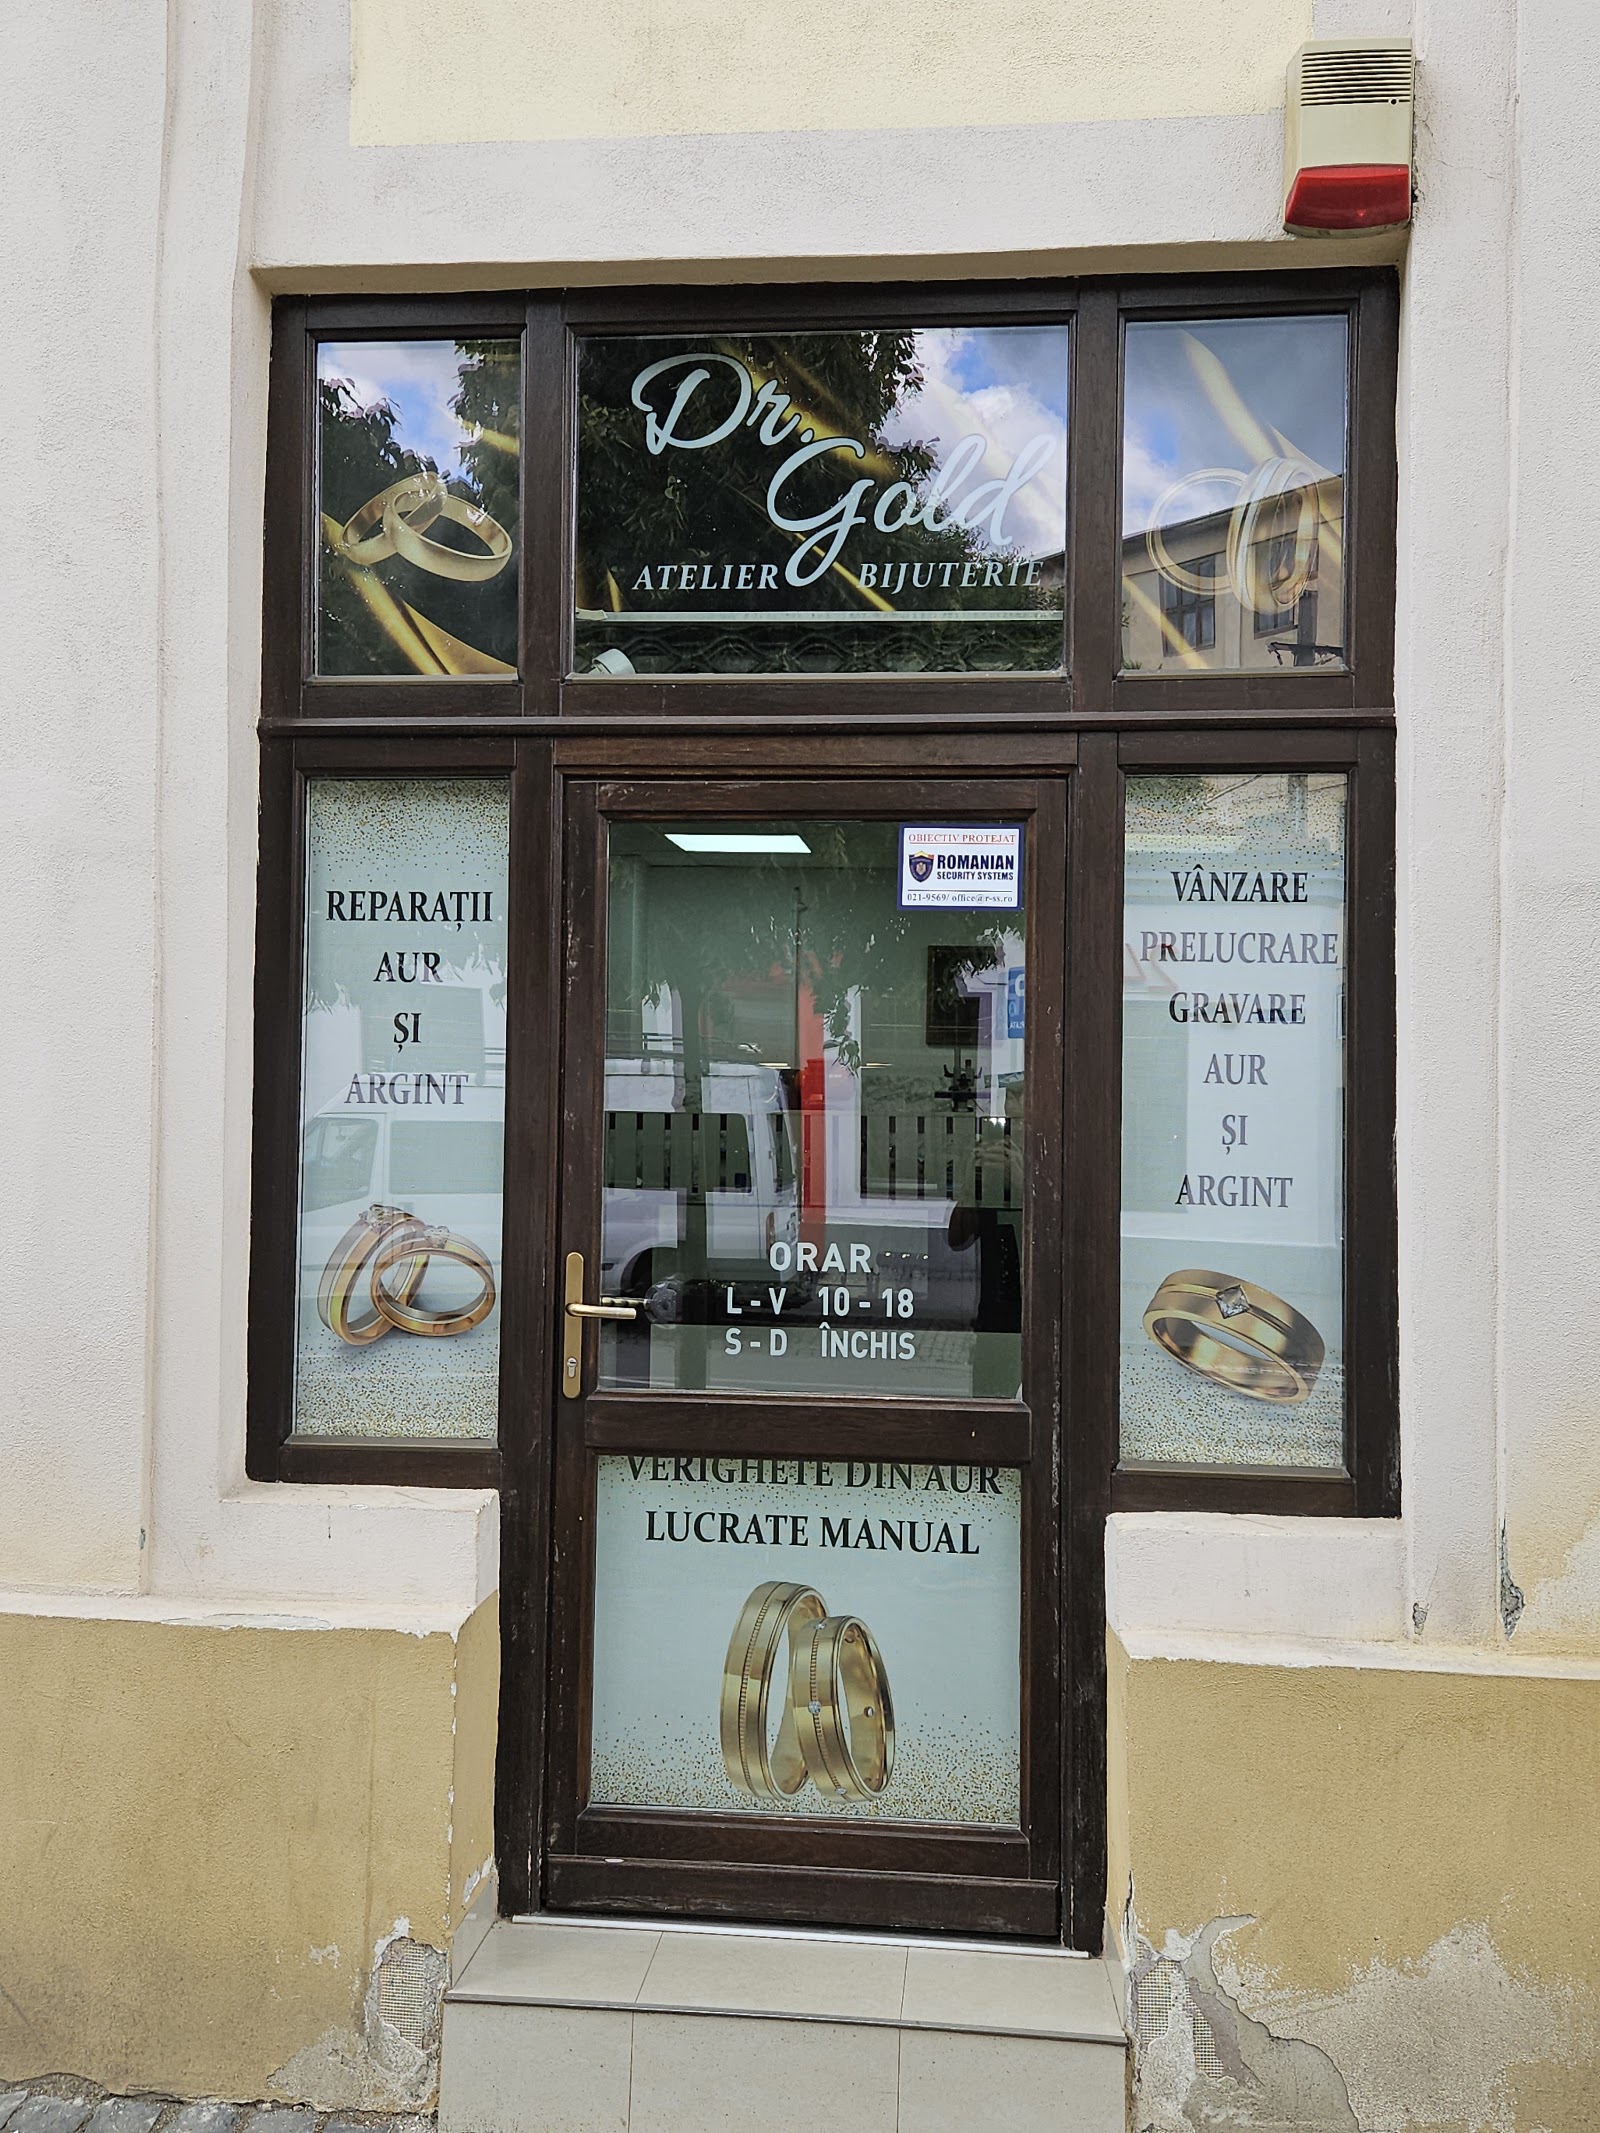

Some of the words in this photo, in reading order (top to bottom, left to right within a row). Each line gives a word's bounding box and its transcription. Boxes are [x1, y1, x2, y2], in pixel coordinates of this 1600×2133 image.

[631, 353, 813, 455] Dr.
[767, 433, 1056, 587] Gold
[632, 563, 779, 590] ATELIER
[858, 561, 1044, 594] BIJUTERIE
[908, 833, 960, 843] OBIECTIV
[962, 834, 1016, 843] PROTEJAT
[937, 854, 1014, 870] ROMANIAN
[937, 871, 975, 880] SECURITY
[977, 872, 1014, 880] SYSTEMS
[1170, 863, 1308, 903] VÂNZARE
[325, 890, 494, 932] REPARAȚII
[1139, 931, 1339, 964] PRELUCRARE
[373, 951, 443, 983] AUR
[1169, 992, 1306, 1025] GRAVARE
[393, 1012, 422, 1053] ȘI
[1203, 1053, 1268, 1085] AUR
[343, 1073, 469, 1105] ARGINT
[1221, 1114, 1249, 1155] ȘI
[1174, 1174, 1294, 1208] ARGINT
[769, 1241, 871, 1273] ORAR
[818, 1322, 916, 1360] ÎNCHIS
[845, 1462, 913, 1490] DIN
[922, 1464, 1003, 1495] AUR
[645, 1510, 809, 1547] LUCRATE
[819, 1516, 980, 1554] MANUAL
